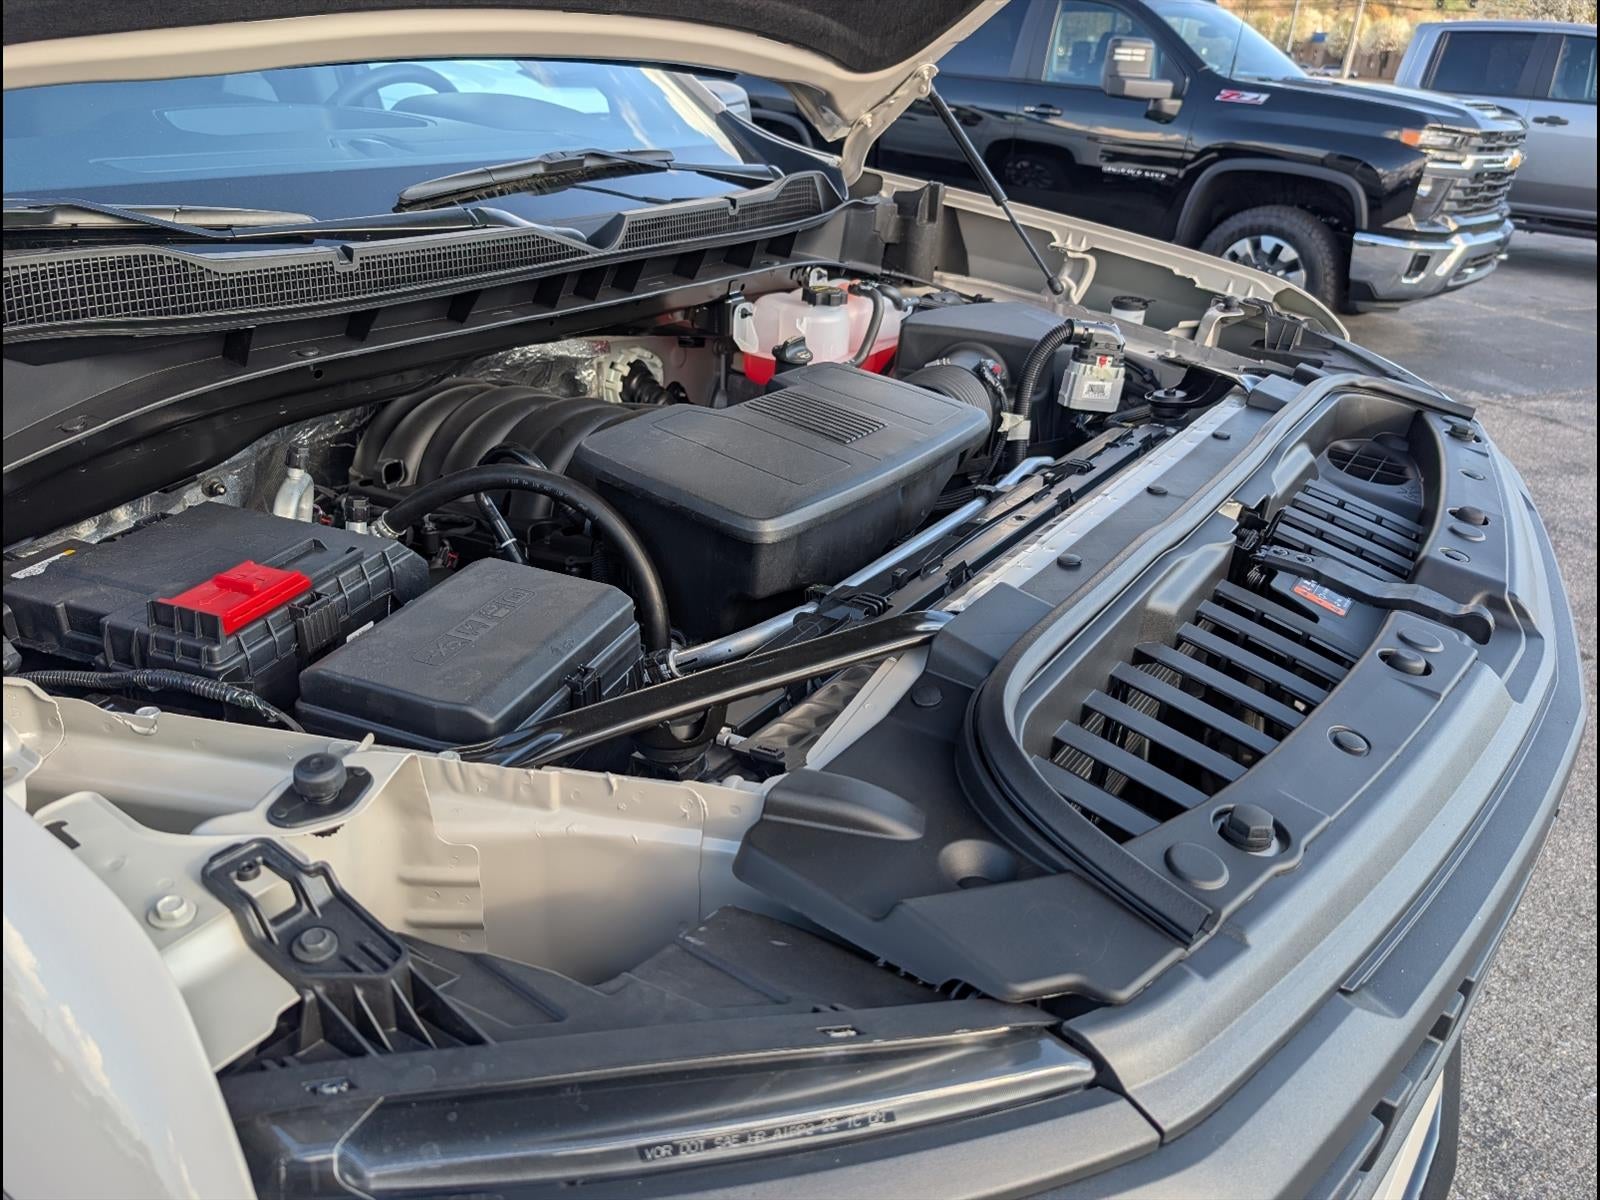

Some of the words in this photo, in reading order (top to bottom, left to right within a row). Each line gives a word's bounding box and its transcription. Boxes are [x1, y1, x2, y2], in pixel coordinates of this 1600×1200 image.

[644, 1144, 673, 1161] VOR
[679, 1139, 706, 1154] DOT
[713, 1134, 741, 1149] SAE
